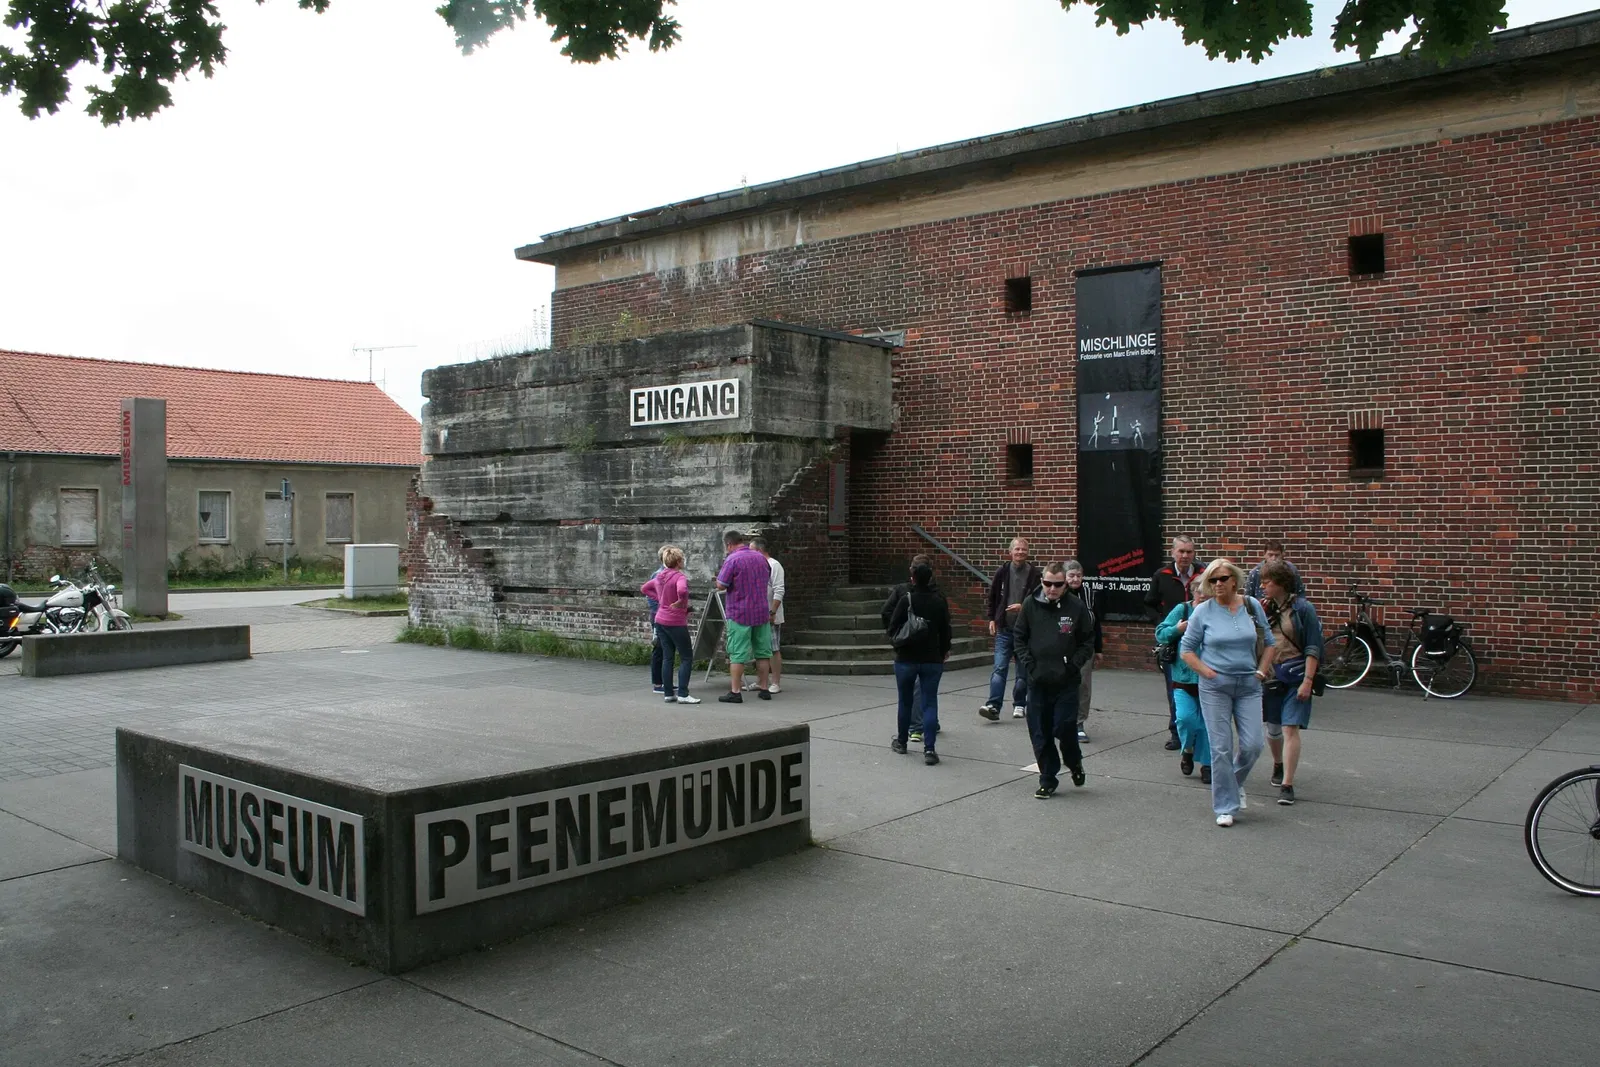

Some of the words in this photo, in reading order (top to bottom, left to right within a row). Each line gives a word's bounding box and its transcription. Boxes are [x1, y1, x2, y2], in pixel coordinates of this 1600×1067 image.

[1080, 333, 1156, 352] MISCHLINGE
[633, 382, 735, 422] EINGANG
[123, 410, 131, 486] MUSEUM
[1092, 582, 1104, 590] Mai
[1108, 583, 1118, 591] 31.
[1119, 583, 1141, 592] August
[1141, 583, 1151, 591] 20
[184, 773, 357, 902] MUSEUM
[427, 751, 803, 900] PEENEMÜNDE
